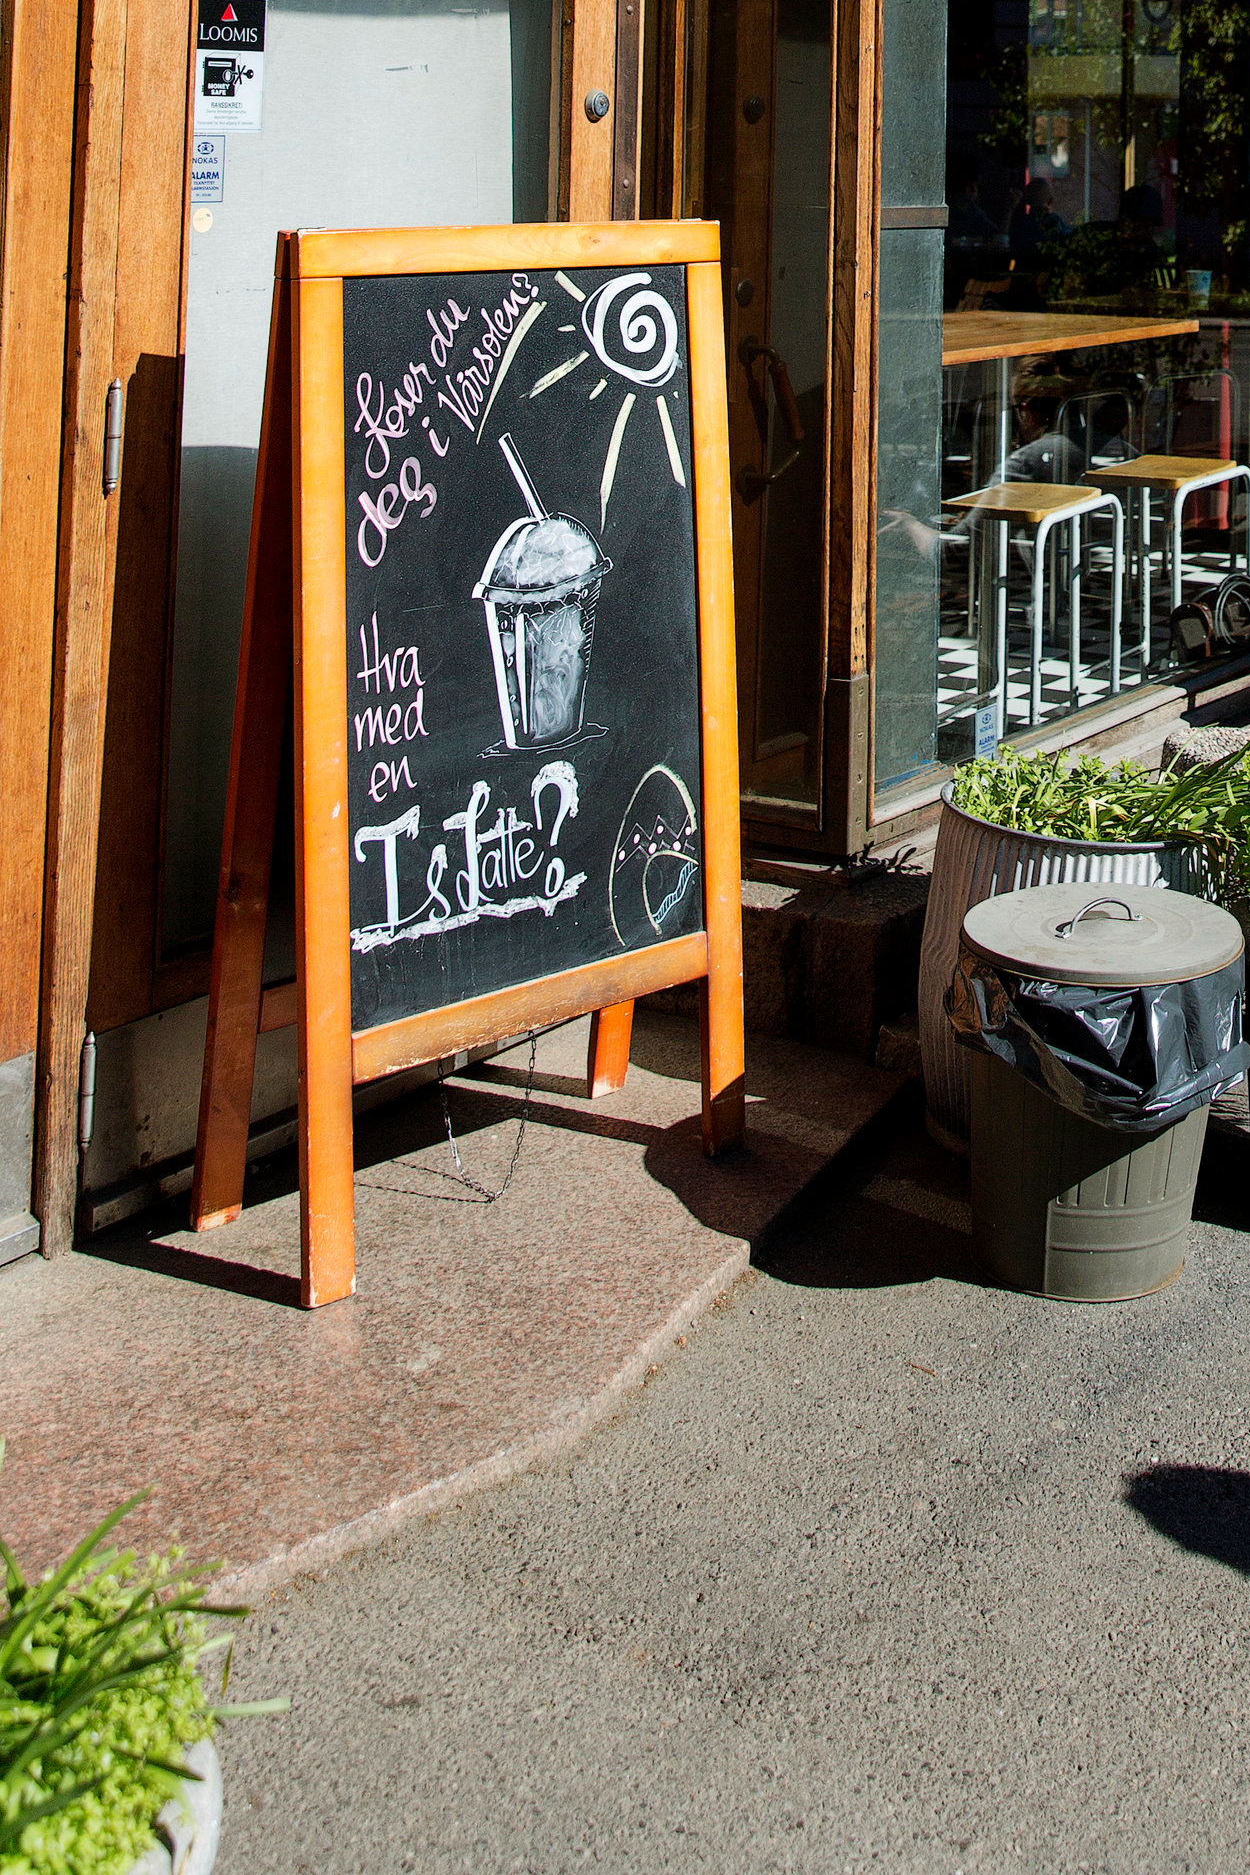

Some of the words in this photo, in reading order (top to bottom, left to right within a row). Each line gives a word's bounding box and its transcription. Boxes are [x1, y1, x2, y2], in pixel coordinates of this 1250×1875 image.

[200, 23, 258, 43] LOOMIS
[207, 82, 231, 90] MONEY
[430, 298, 471, 368] du
[421, 415, 450, 458] i
[356, 610, 426, 695] Hva
[353, 687, 430, 753] med
[367, 755, 418, 803] en
